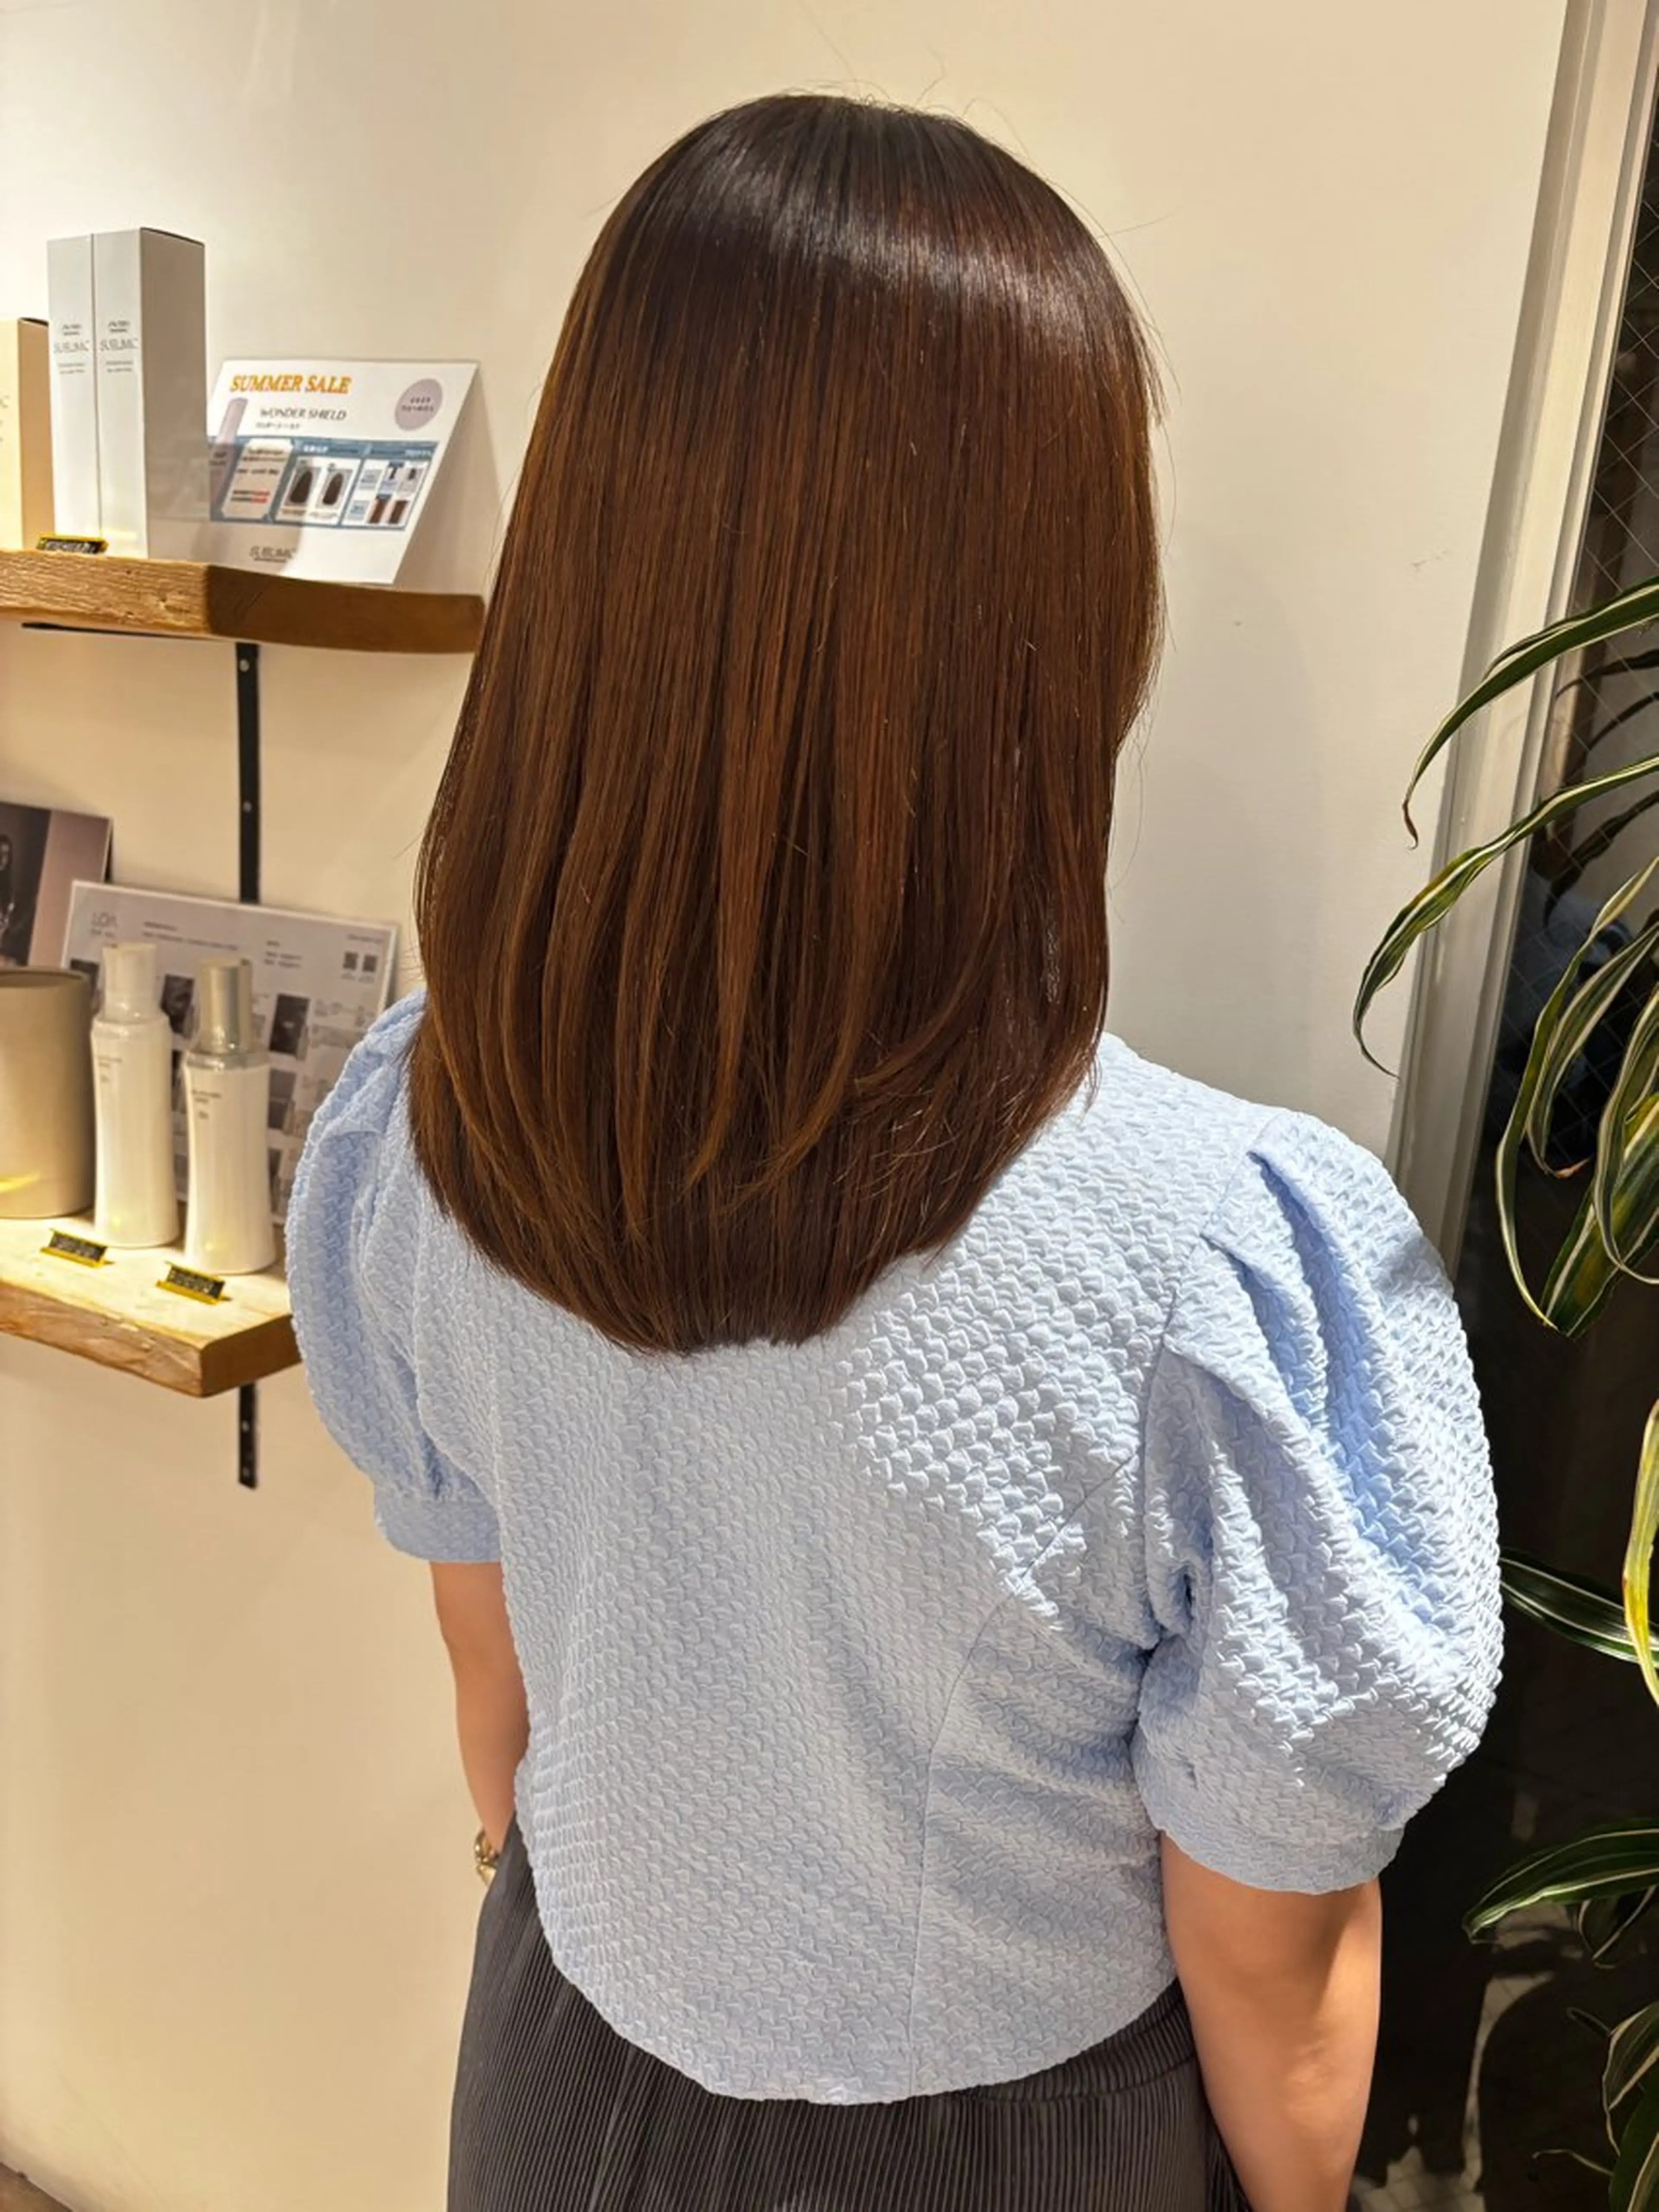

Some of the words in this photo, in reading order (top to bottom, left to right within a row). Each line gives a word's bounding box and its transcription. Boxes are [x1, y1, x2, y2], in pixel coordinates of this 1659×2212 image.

[231, 375, 303, 392] SUMMER
[305, 375, 352, 394] SALE
[260, 407, 305, 419] WONDER
